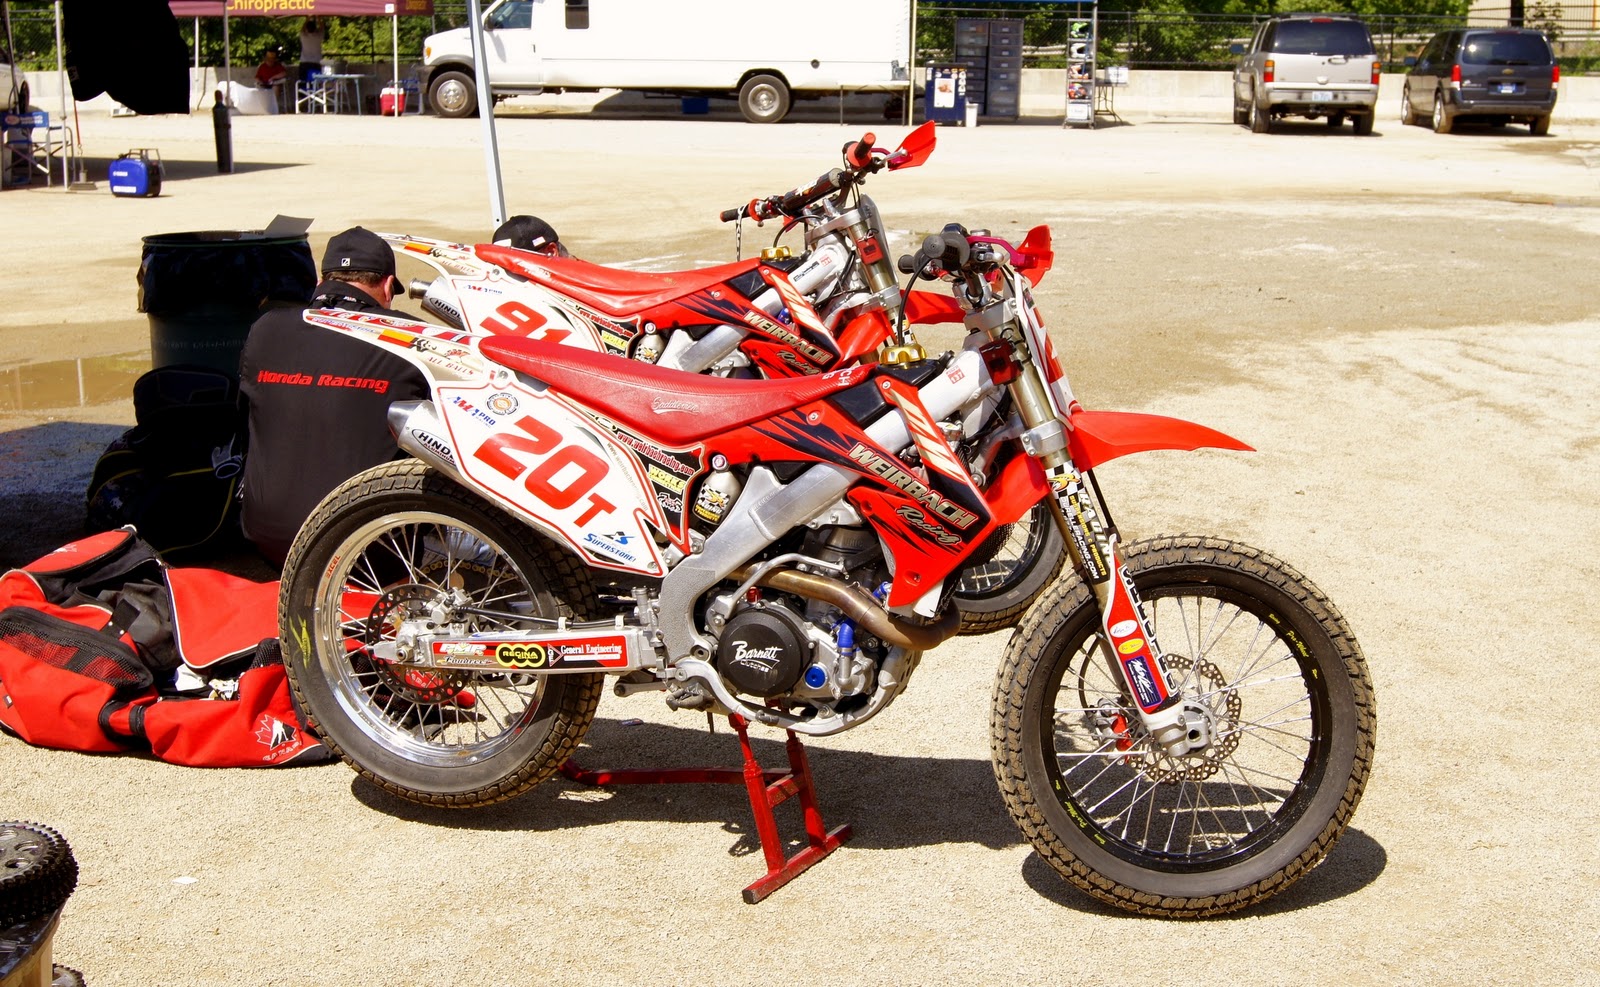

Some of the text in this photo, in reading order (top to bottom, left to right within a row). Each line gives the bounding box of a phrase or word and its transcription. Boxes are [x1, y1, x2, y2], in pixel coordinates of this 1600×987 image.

[743, 310, 834, 366] WEIRBACH
[777, 350, 821, 375] Racing
[257, 370, 390, 394] Honda Racing
[478, 412, 497, 426] PRO
[848, 443, 979, 529] WEIRBACH
[896, 505, 962, 544] Racing
[503, 650, 538, 658] REGINA
[560, 644, 622, 656] General Engineering
[732, 641, 783, 660] Barnett
